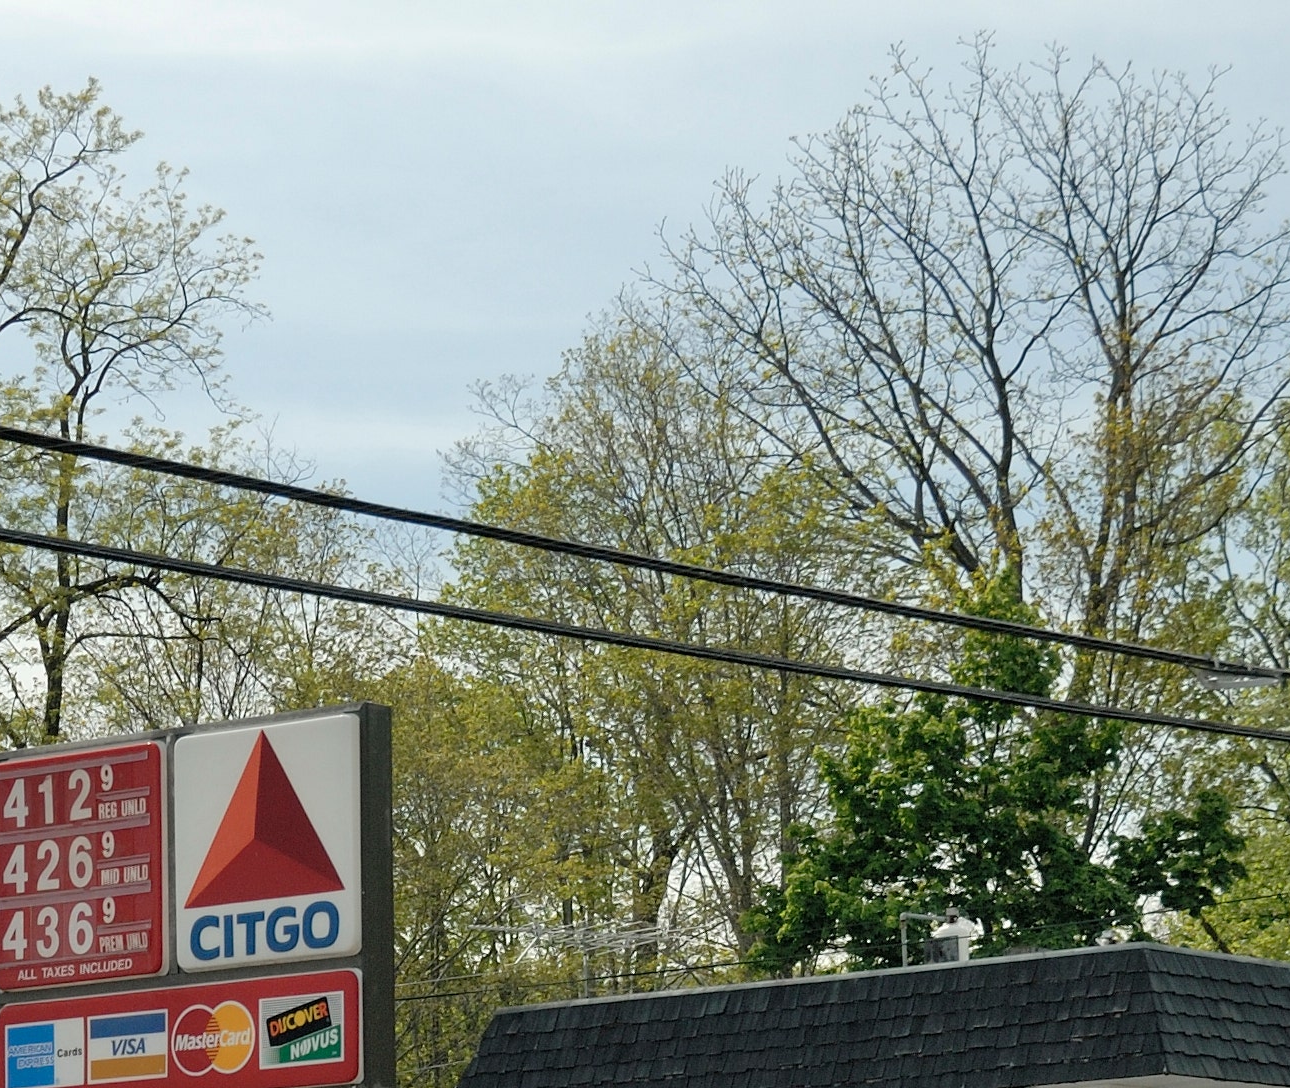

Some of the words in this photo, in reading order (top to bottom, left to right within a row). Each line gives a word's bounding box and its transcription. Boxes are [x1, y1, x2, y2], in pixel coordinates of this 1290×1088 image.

[98, 800, 117, 820] REG
[121, 797, 147, 817] UNLD
[101, 867, 119, 887] MID
[123, 864, 148, 884] UNLD
[99, 934, 124, 953] PREM
[127, 931, 149, 950] UNLD
[189, 900, 340, 962] CITGO
[17, 969, 37, 981] ALL
[41, 964, 75, 979] TAXES
[79, 958, 133, 975] INCLUDED
[269, 1001, 329, 1037] DISCOVER
[8, 1042, 53, 1058] AMERICAN
[111, 1037, 147, 1056] VISA
[174, 1027, 251, 1052] MasterCard
[289, 1028, 339, 1060] NOVUS
[16, 1055, 55, 1070] EXPRESS
[56, 1046, 83, 1058] Cards
